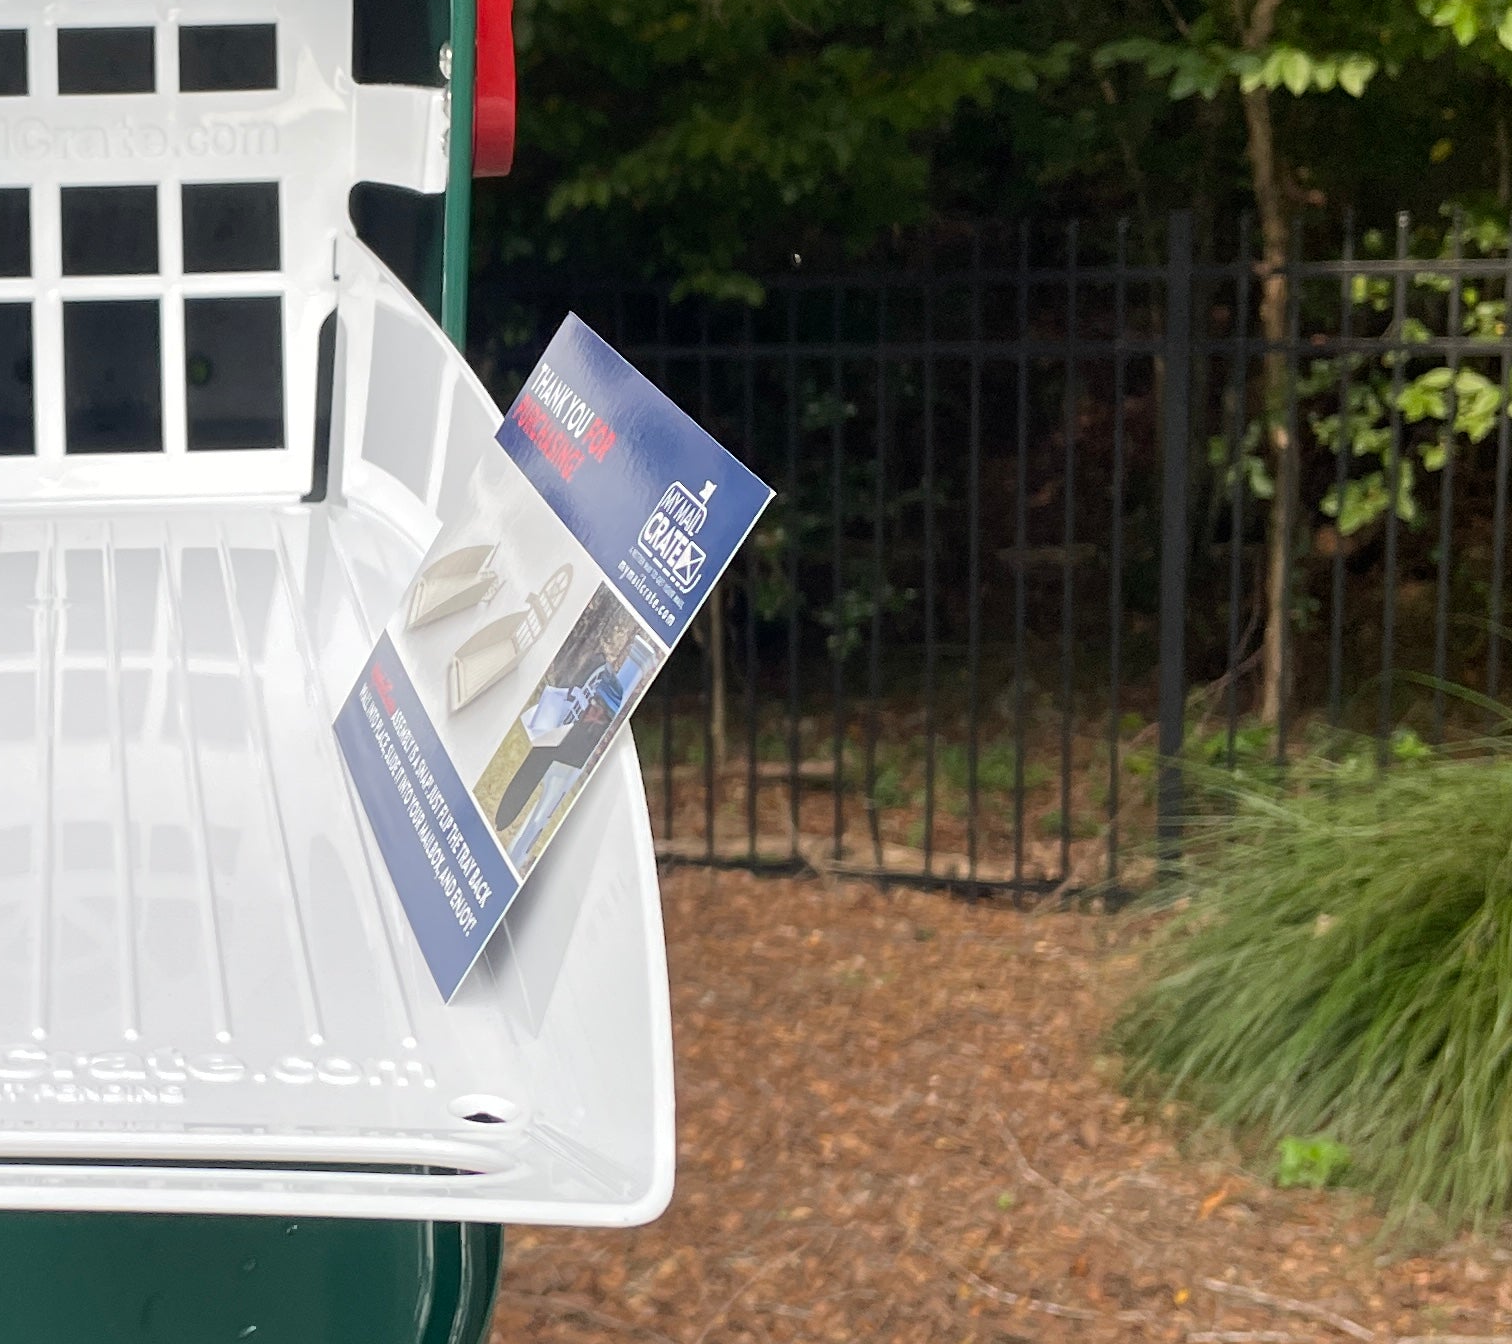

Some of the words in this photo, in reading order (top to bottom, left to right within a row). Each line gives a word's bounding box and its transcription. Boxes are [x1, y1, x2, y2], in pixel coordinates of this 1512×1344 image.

[512, 393, 585, 483] PURCHASING!
[531, 362, 573, 417] THANK
[561, 394, 595, 439] YOU
[582, 416, 616, 463] FOR
[643, 511, 689, 567] CRATE
[661, 487, 684, 515] MY
[673, 503, 702, 537] MAIL
[618, 559, 676, 627] mymailcrate.com
[383, 744, 401, 776] SLIDE
[397, 775, 414, 806] INTO
[406, 795, 425, 831] YOUR
[416, 819, 446, 877] MAILBOX,
[438, 863, 458, 899] AND
[449, 887, 476, 938] ENJOY!
[390, 707, 415, 754] ASSEMBLY
[407, 743, 419, 763] IS
[426, 783, 444, 815] JUST
[436, 804, 454, 834] FLIP
[445, 823, 464, 854] THE
[455, 842, 476, 880] TRAY
[468, 867, 491, 909] BACK
[32, 1083, 186, 1105] PENDING
